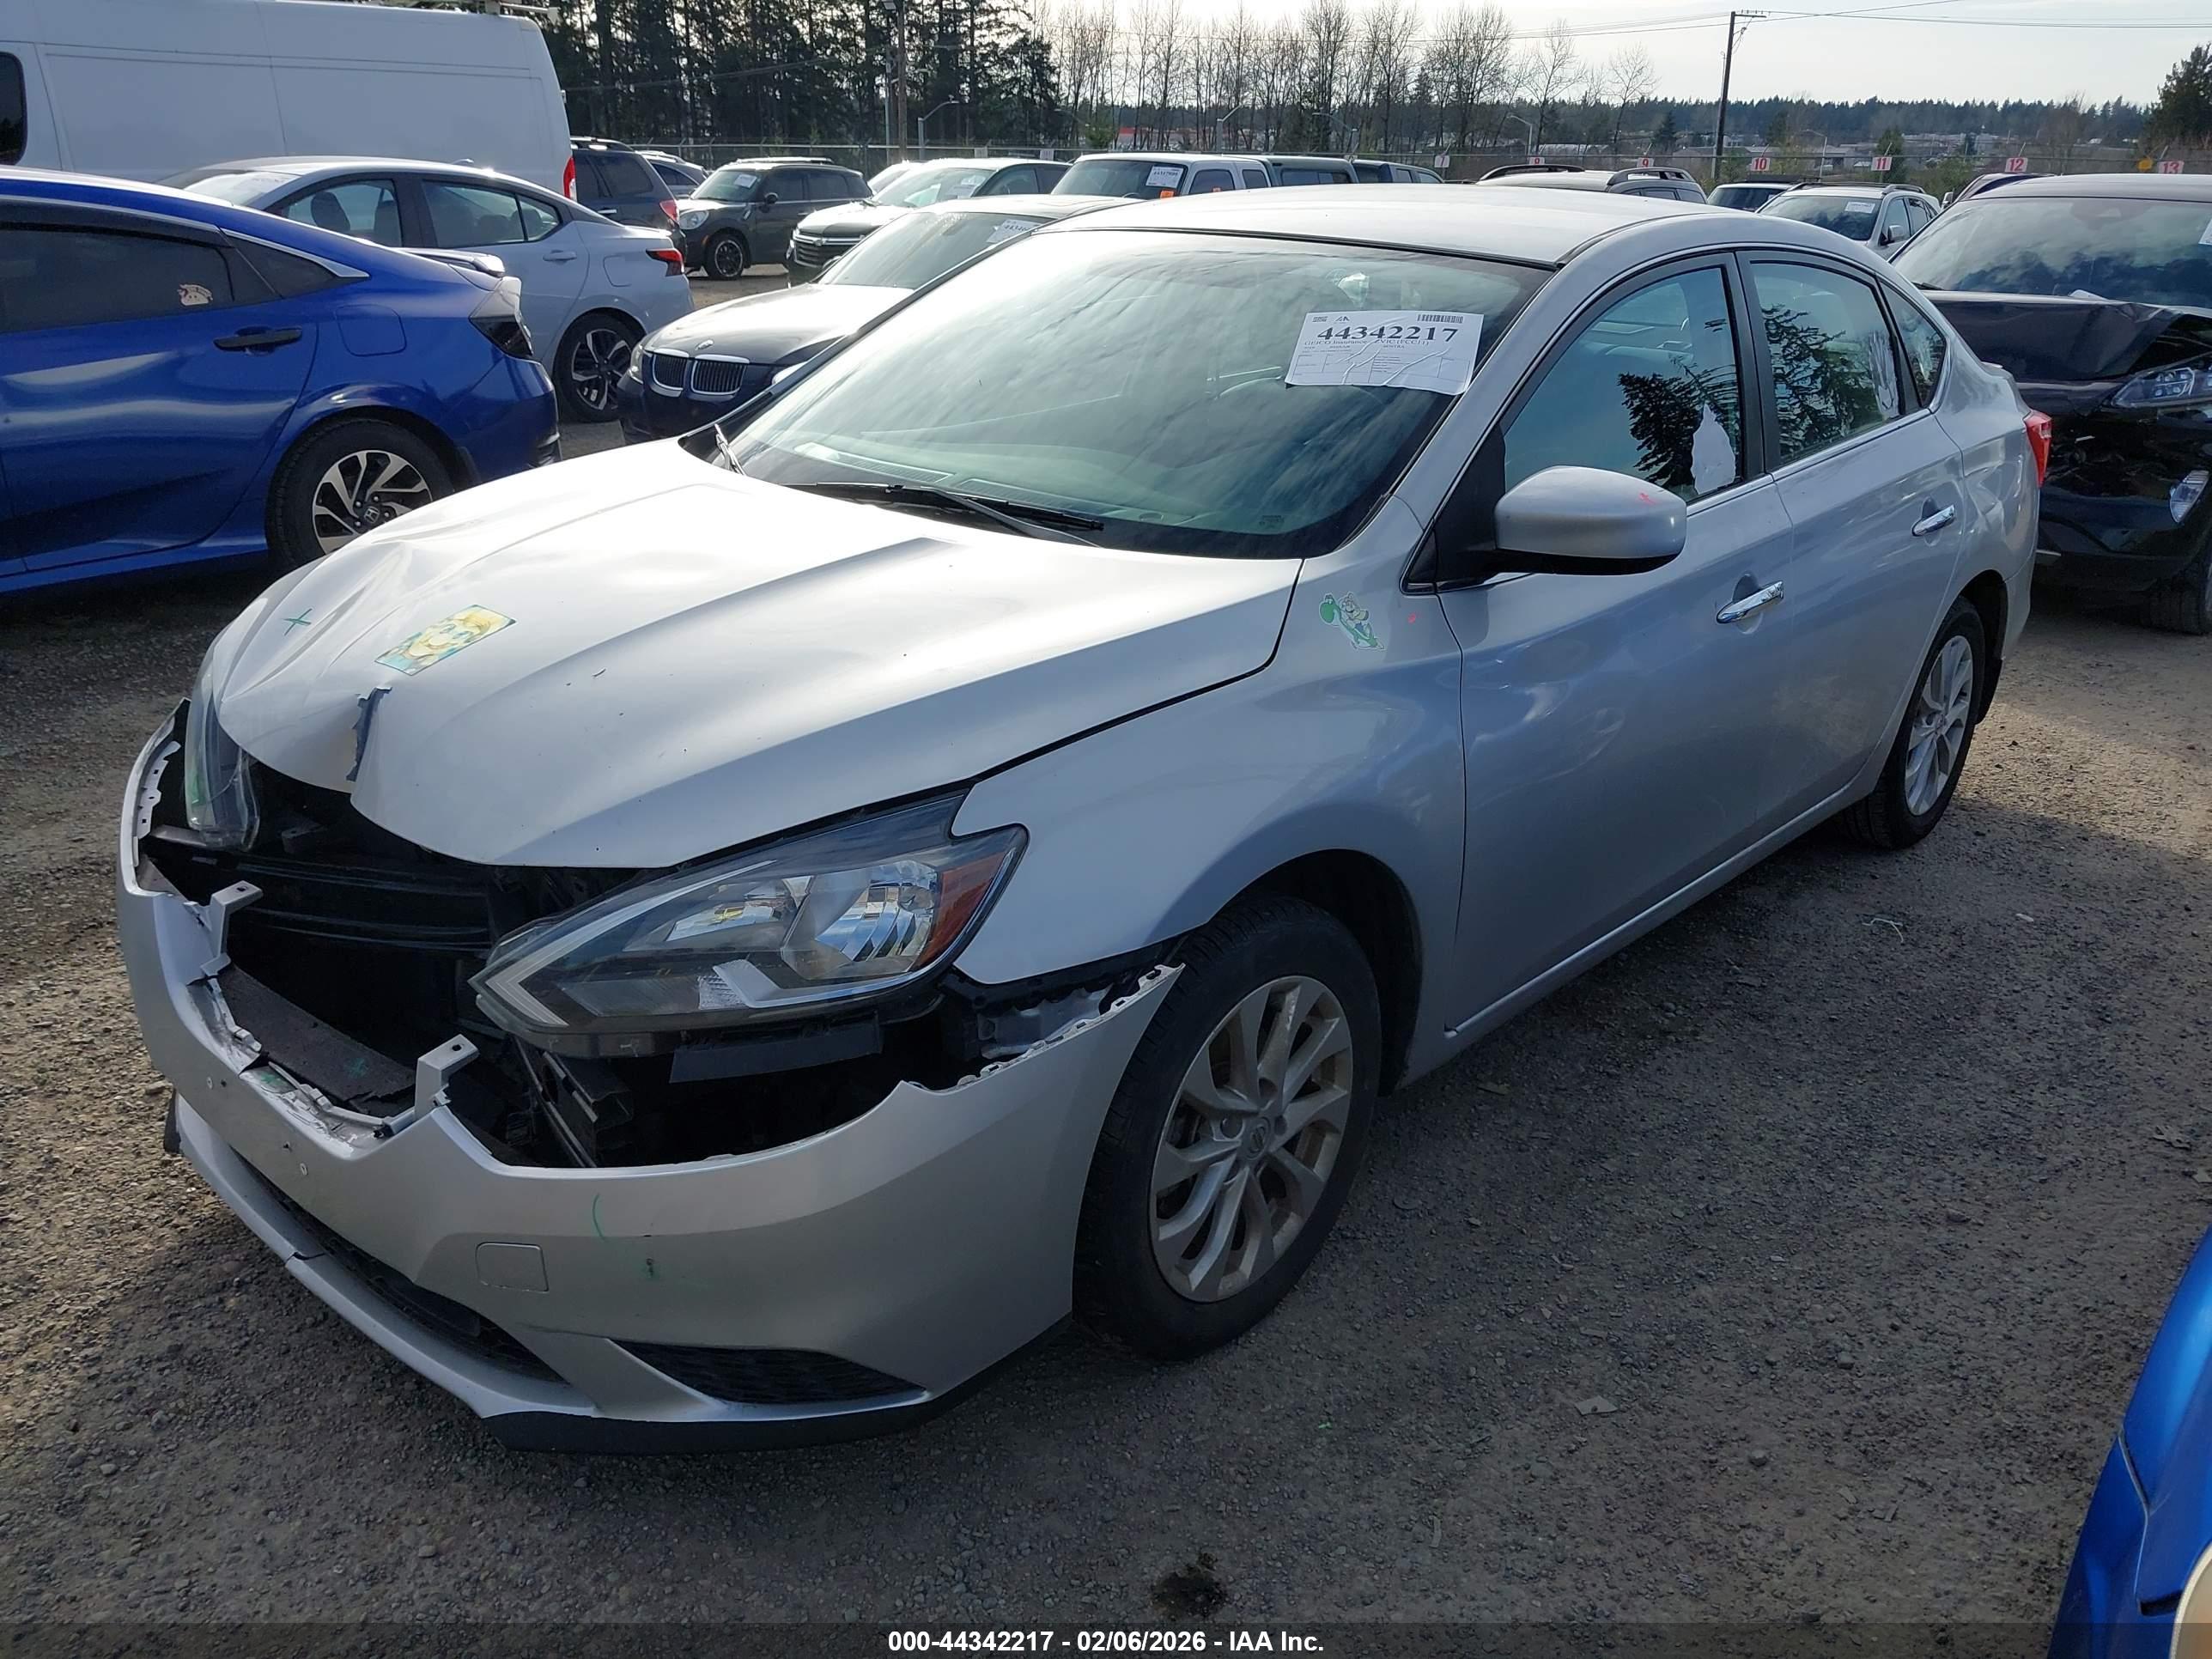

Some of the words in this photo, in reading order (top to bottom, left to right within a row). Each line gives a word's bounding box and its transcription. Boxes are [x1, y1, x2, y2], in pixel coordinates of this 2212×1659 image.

[1642, 158, 1649, 167] 9
[1755, 158, 1767, 170] 10
[1876, 157, 1887, 170] 11
[2009, 158, 2024, 171] 12
[2163, 161, 2179, 174] 13
[1317, 325, 1459, 343] 44342217
